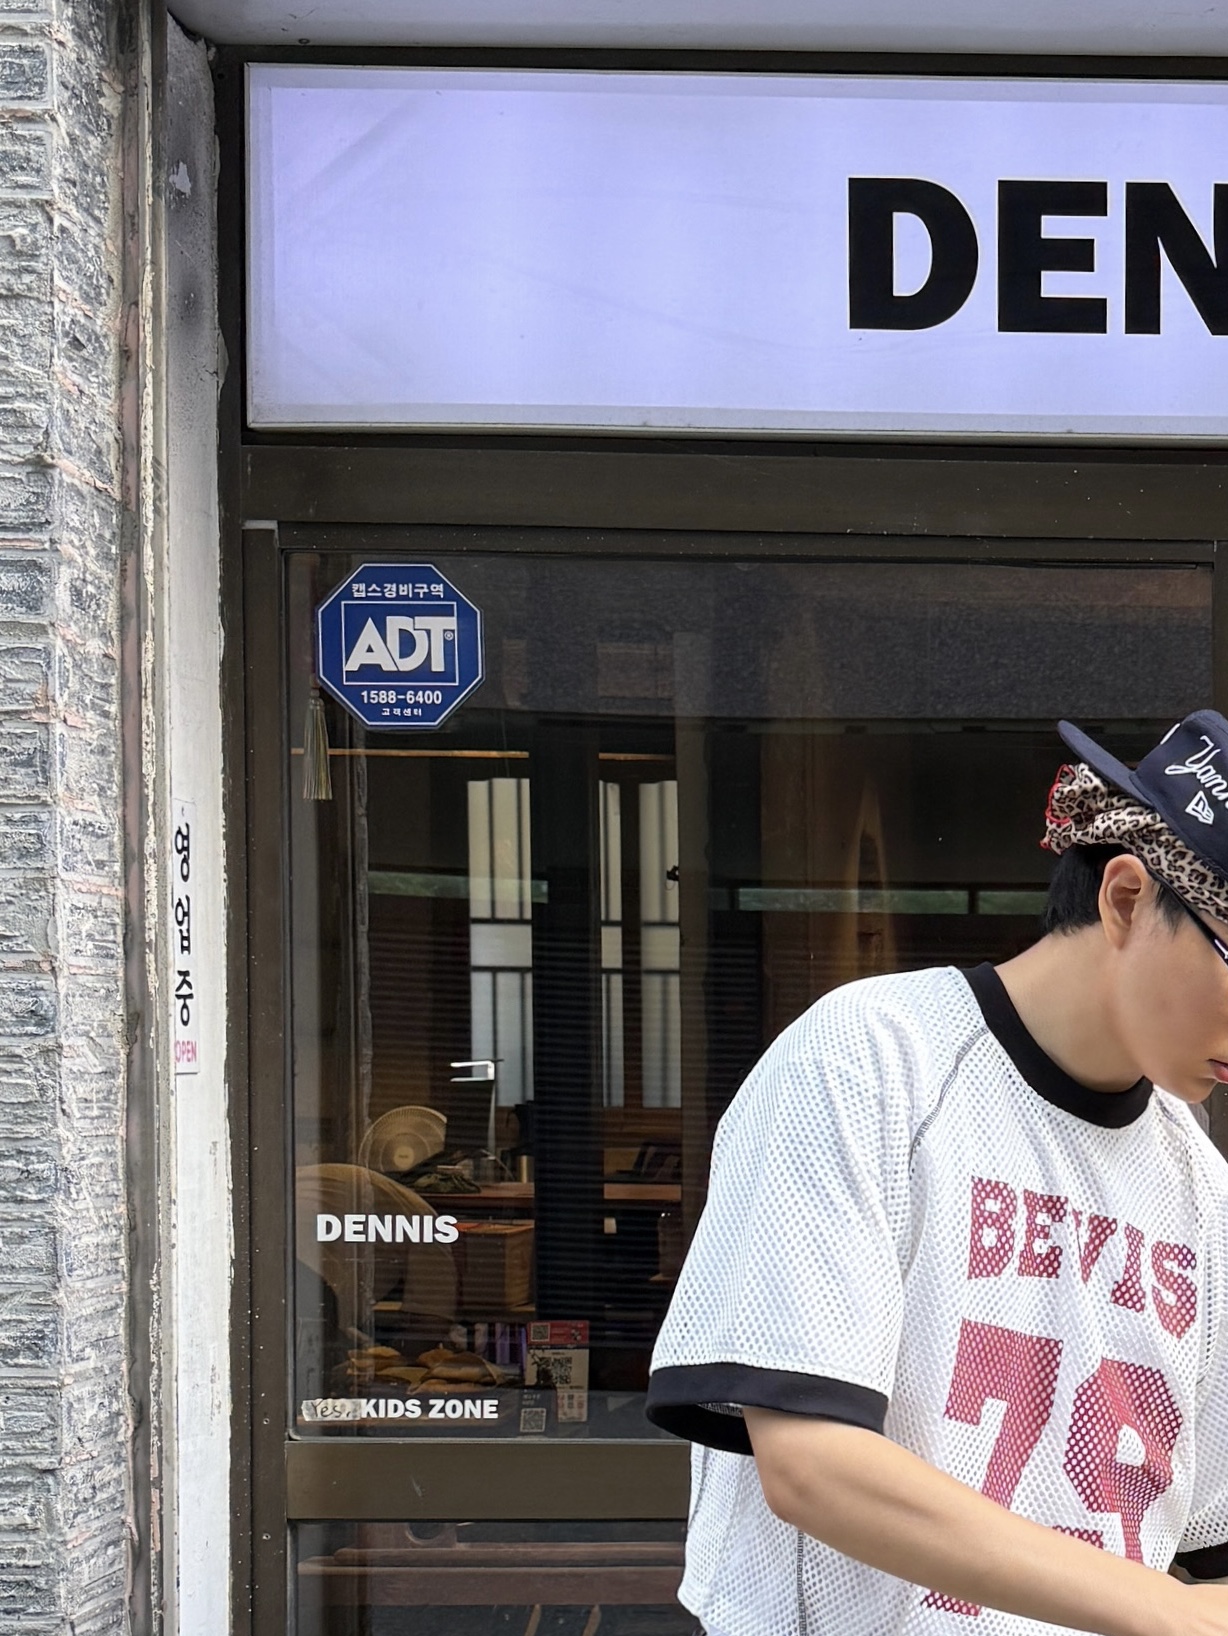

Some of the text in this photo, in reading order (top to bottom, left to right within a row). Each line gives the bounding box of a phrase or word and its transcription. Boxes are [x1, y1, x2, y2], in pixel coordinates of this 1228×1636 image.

[351, 583, 445, 599] 캡스경비구역
[344, 615, 457, 672] ADT
[361, 690, 442, 704] 1588-6400
[174, 1040, 198, 1063] OPEN
[316, 1213, 460, 1244] DENNIS
[967, 1175, 1197, 1338] BEVIS
[361, 1398, 422, 1418] KIDS
[428, 1398, 499, 1419] ZONE
